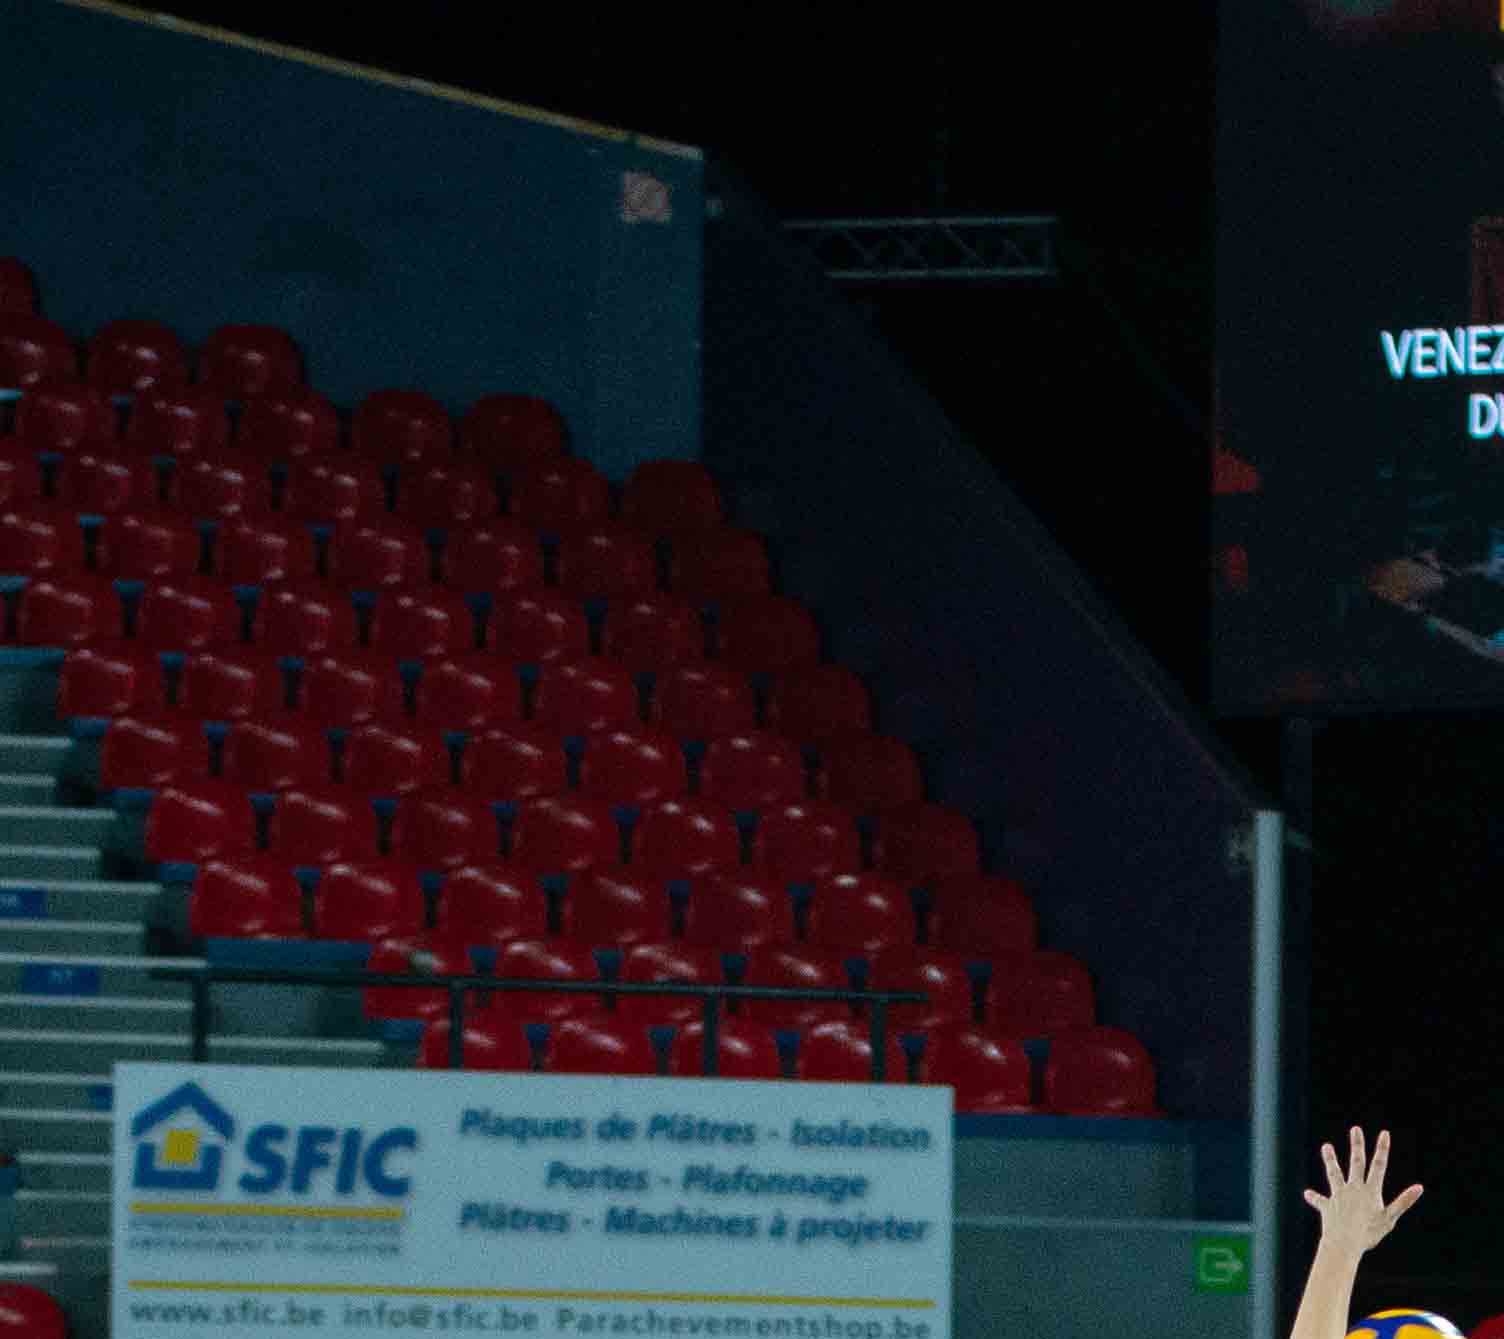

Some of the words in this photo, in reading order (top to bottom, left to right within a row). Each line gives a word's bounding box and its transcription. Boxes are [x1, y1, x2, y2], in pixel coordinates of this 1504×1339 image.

[459, 1108, 585, 1146] Plaques
[596, 1111, 637, 1142] de
[647, 1112, 757, 1146] Plâtres
[790, 1118, 932, 1149] Isolation
[238, 1121, 419, 1197] SFIC
[545, 1160, 650, 1193] Portes
[682, 1163, 869, 1205] Plafonnage
[459, 1202, 571, 1234] Plâtres
[605, 1206, 760, 1239] Machines
[769, 1210, 788, 1239] à
[795, 1211, 930, 1248] projeter
[129, 1299, 326, 1329] www.sfic.be
[344, 1301, 539, 1333] info@sfic.be
